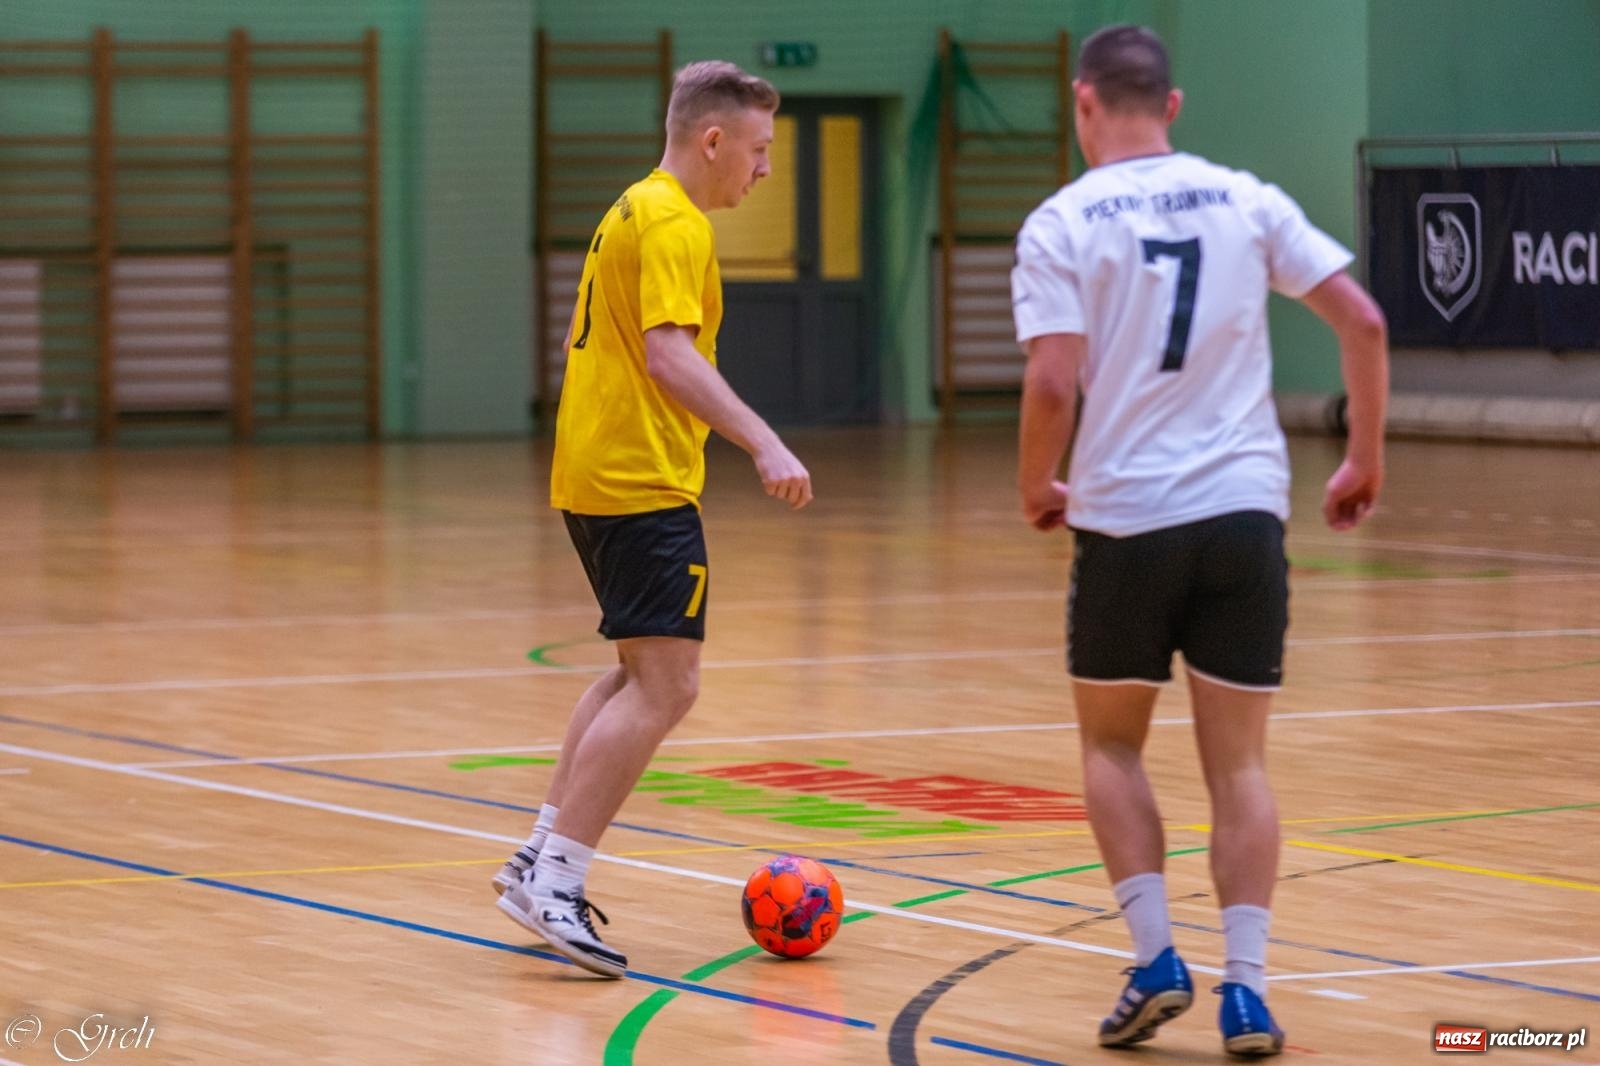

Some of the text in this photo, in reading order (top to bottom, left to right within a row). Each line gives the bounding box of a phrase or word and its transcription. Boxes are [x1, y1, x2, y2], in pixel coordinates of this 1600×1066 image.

[1512, 230, 1598, 285] RACI
[1141, 237, 1200, 372] 7
[684, 563, 707, 617] 7
